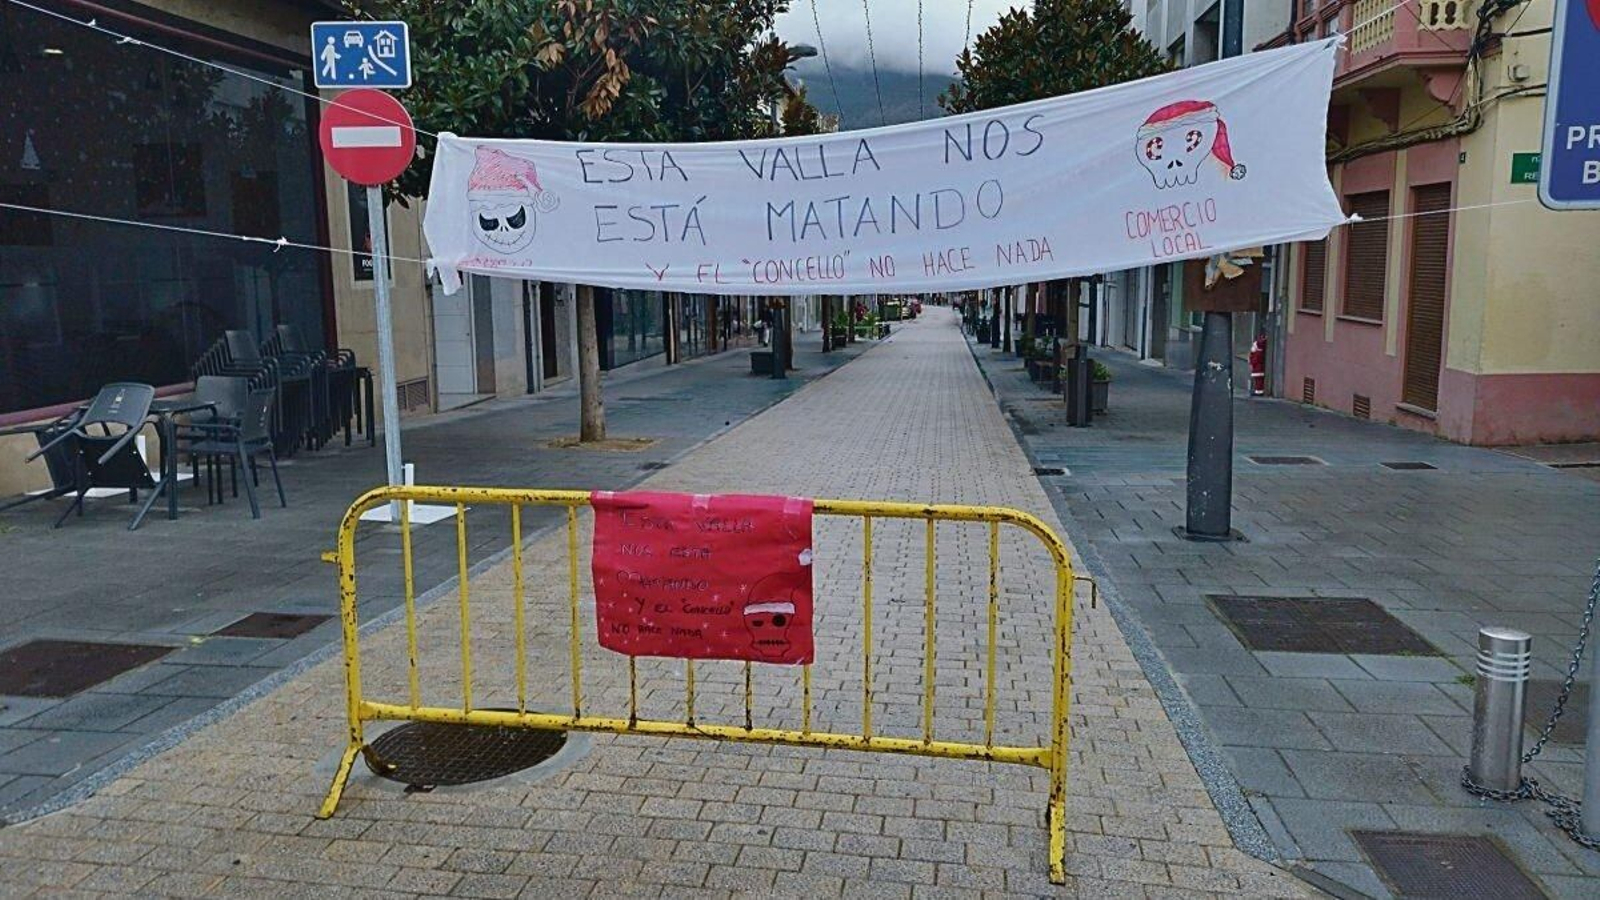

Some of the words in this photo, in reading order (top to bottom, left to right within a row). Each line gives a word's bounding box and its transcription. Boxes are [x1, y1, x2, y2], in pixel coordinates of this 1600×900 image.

[576, 149, 688, 183] ESTA
[738, 138, 881, 181] VALLA
[944, 114, 1045, 164] NOS
[594, 195, 707, 246] ESTÁ
[767, 179, 1004, 243] MATANDO
[1125, 197, 1217, 239] COMERCIO
[645, 262, 670, 281] Y
[869, 255, 895, 278] NO
[923, 247, 975, 276] HACE
[996, 237, 1053, 266] NADA
[1151, 232, 1214, 257] LOCAL
[635, 597, 646, 615] Y
[611, 623, 631, 635] NO
